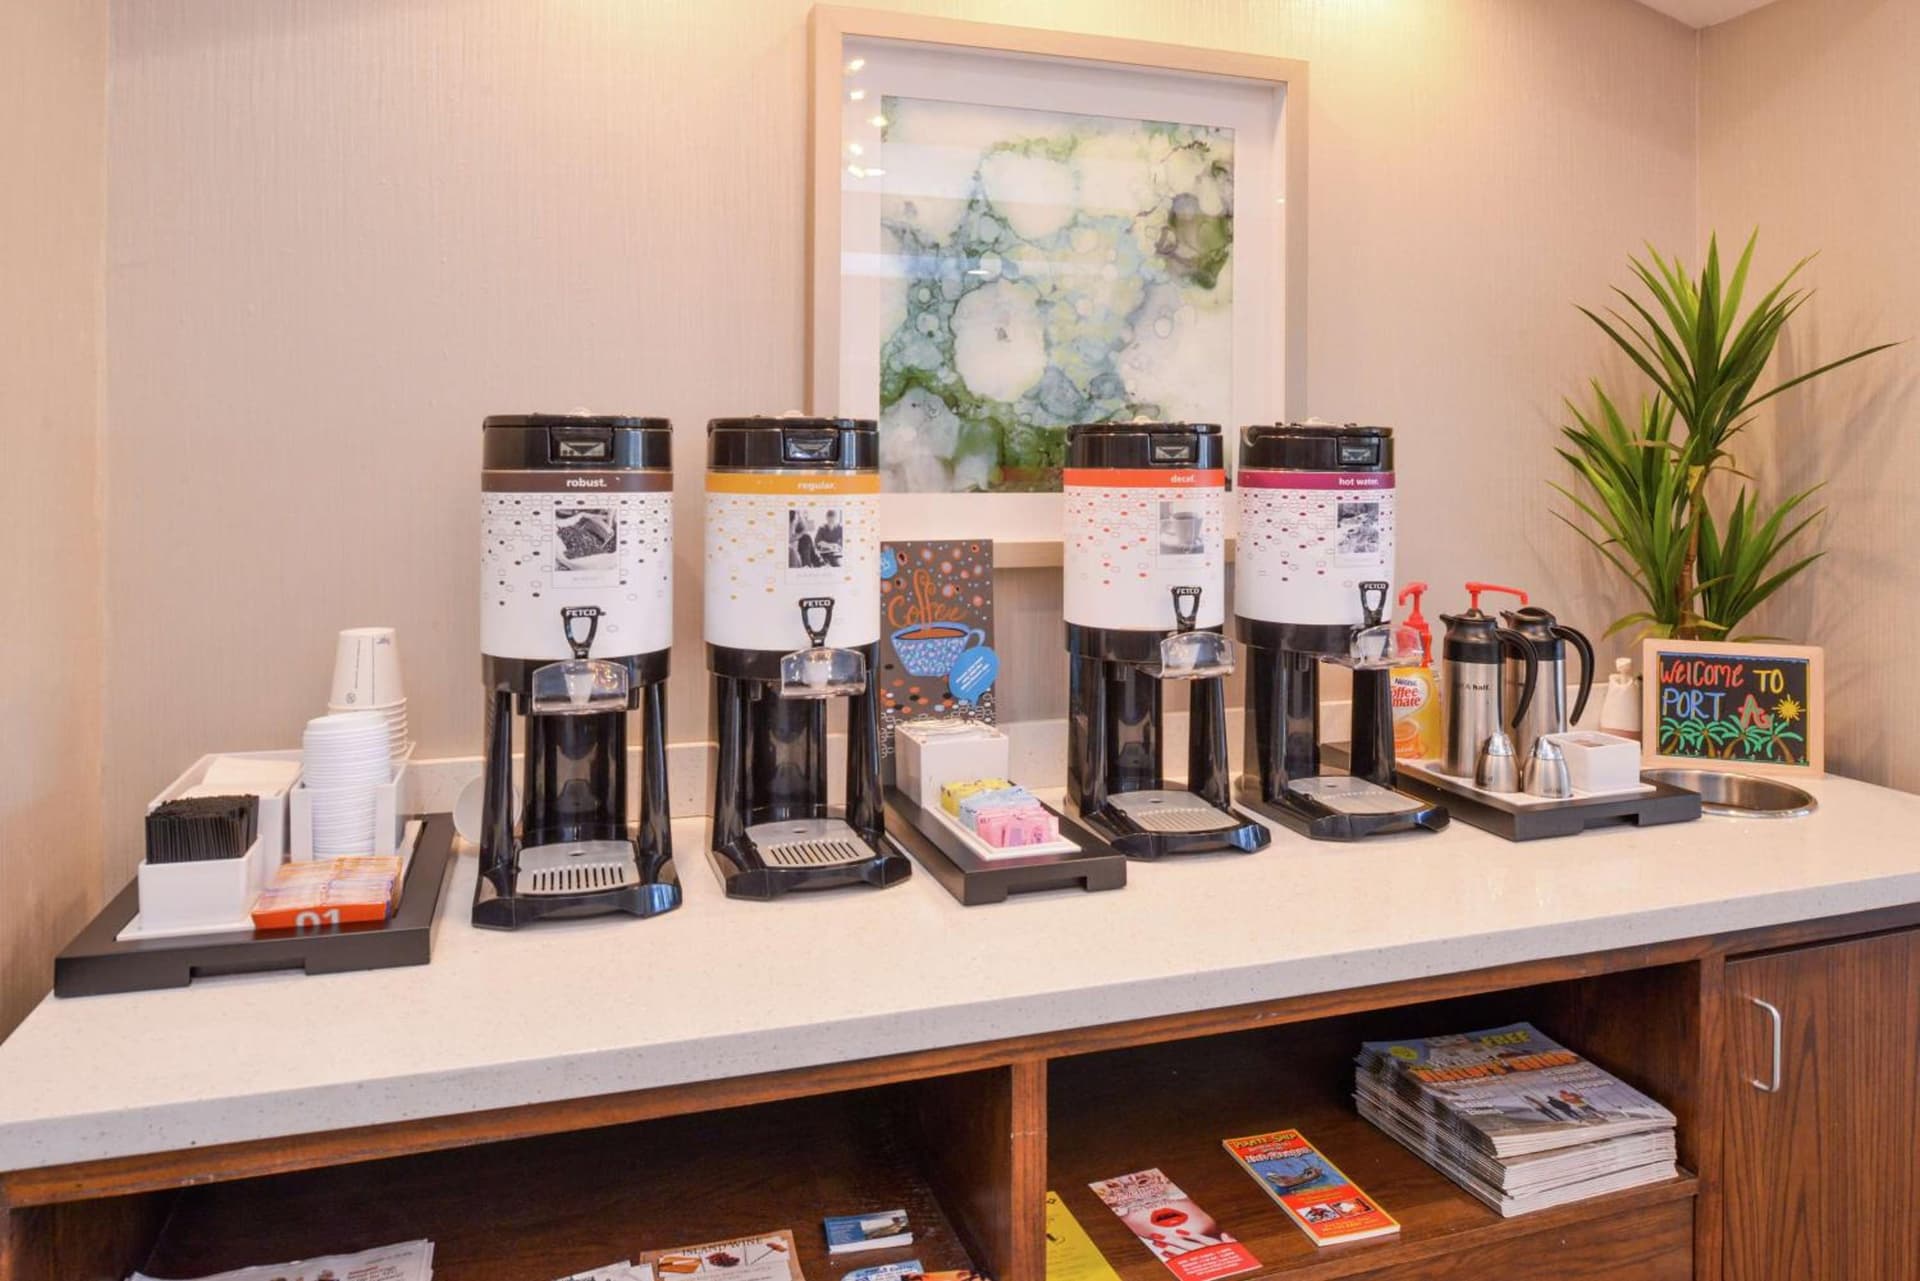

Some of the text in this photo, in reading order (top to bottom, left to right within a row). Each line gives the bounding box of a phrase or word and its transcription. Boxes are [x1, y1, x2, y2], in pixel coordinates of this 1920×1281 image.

[566, 477, 607, 487] robust.
[803, 599, 831, 607] FETCO
[888, 569, 966, 628] Coffee
[566, 609, 597, 617] FETCO
[1391, 686, 1418, 697] offee
[1663, 688, 1726, 721] PORT
